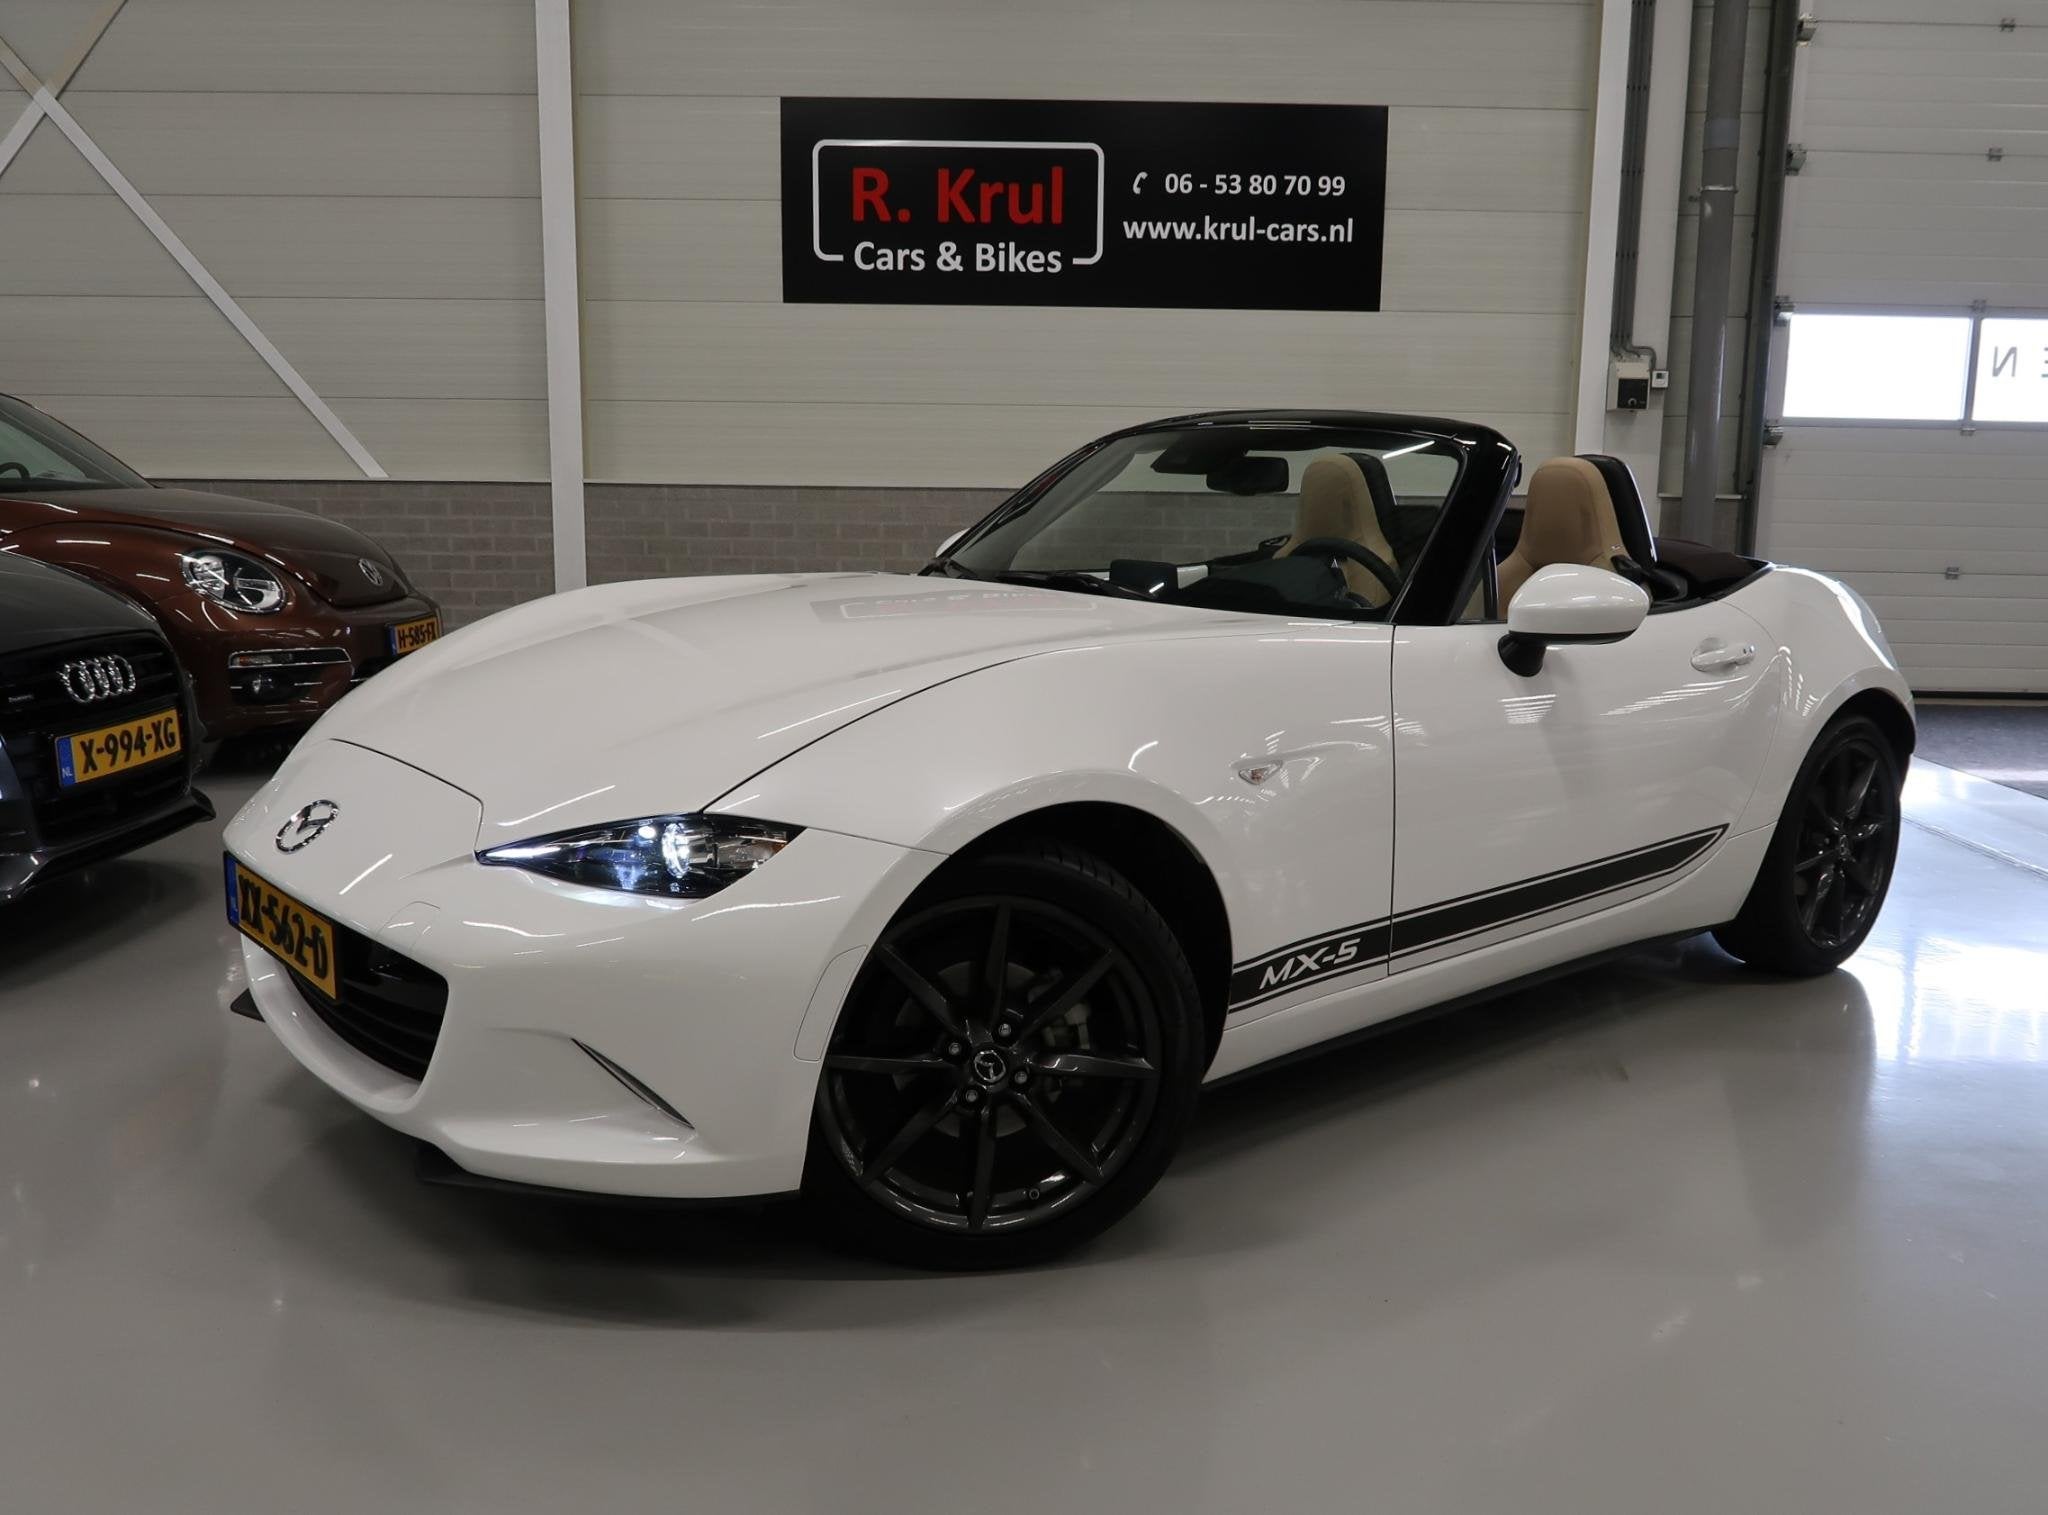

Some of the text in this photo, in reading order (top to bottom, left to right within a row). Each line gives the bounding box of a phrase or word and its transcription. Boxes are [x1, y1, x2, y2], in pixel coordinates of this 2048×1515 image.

[852, 166, 1063, 225] R. Krul
[1165, 173, 1193, 194] 06
[1214, 174, 1242, 195] 53
[1248, 174, 1277, 195] 80
[1283, 175, 1312, 196] 70
[1318, 175, 1346, 196] 99
[1122, 215, 1354, 243] www.krul-cars.nl
[854, 241, 1062, 273] Cars & Bikes
[79, 717, 176, 775] X-994-XG
[1258, 937, 1361, 990] MX-5
